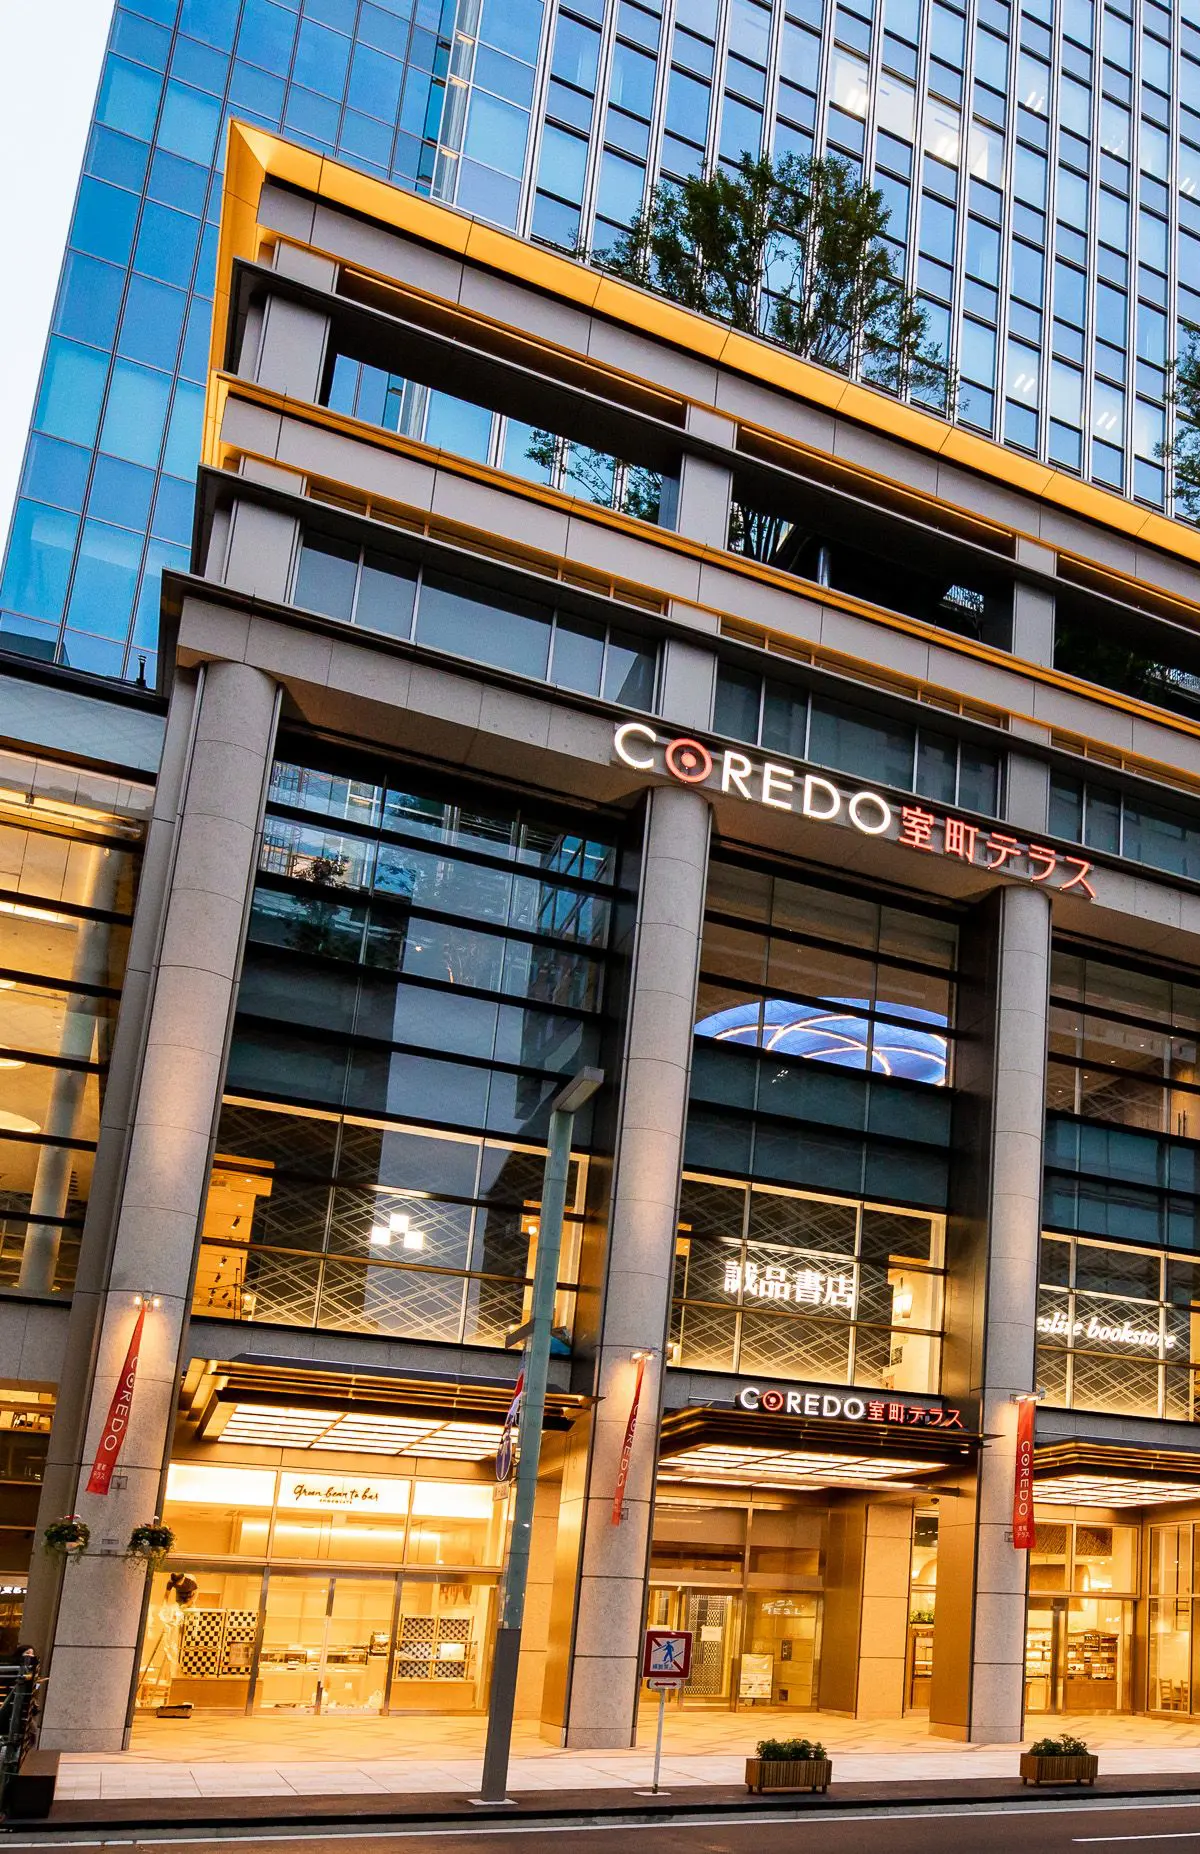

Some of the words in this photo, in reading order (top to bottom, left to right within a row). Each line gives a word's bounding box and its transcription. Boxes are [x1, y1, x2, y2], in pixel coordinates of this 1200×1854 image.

[613, 722, 892, 835] COREDO
[898, 805, 1097, 899] 室町テラス
[723, 1259, 855, 1309] 誠品書店
[104, 1356, 139, 1451] COREDO
[740, 1387, 866, 1420] COREDO
[867, 1399, 965, 1429] 室町テラス
[1018, 1440, 1030, 1516] COREDO
